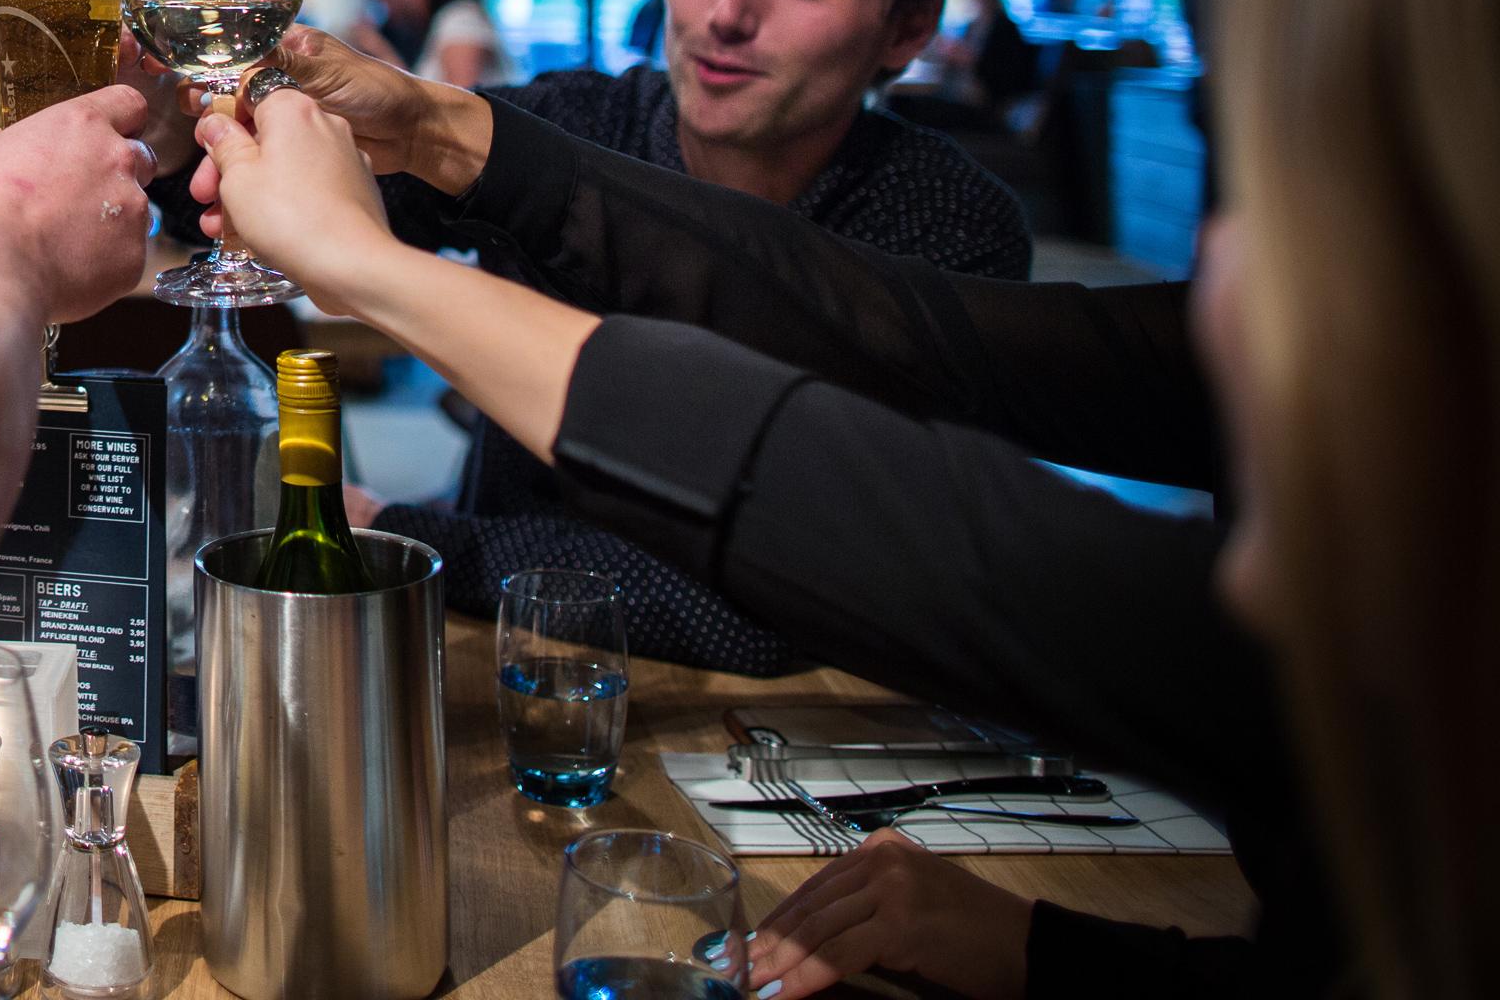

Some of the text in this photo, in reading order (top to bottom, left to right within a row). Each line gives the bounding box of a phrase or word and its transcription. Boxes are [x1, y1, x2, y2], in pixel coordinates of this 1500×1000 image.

[76, 440, 137, 453] MORE WINES
[74, 452, 140, 464] ASK YOUR SERVER
[81, 462, 132, 474] FOR OUR FULL
[88, 473, 125, 483] WINE LIST
[80, 483, 132, 494] OR A VISIT TO
[88, 495, 124, 504] OUR WINE
[77, 504, 134, 515] CONSERVATORY
[29, 555, 53, 565] France
[37, 581, 81, 597] BEERS
[38, 598, 53, 607] TAP
[59, 601, 89, 611] DRAFT:
[40, 610, 146, 627] HEINEKEN 2,55
[40, 620, 68, 630] BRAND
[68, 623, 95, 633] ZWAAR
[96, 625, 124, 635] BLOND
[40, 631, 78, 642] AFFLIGEM
[78, 634, 106, 644] BLOND
[91, 663, 115, 671] BRAZIL)
[93, 715, 120, 724] HOUSE
[120, 717, 134, 726] IPA
